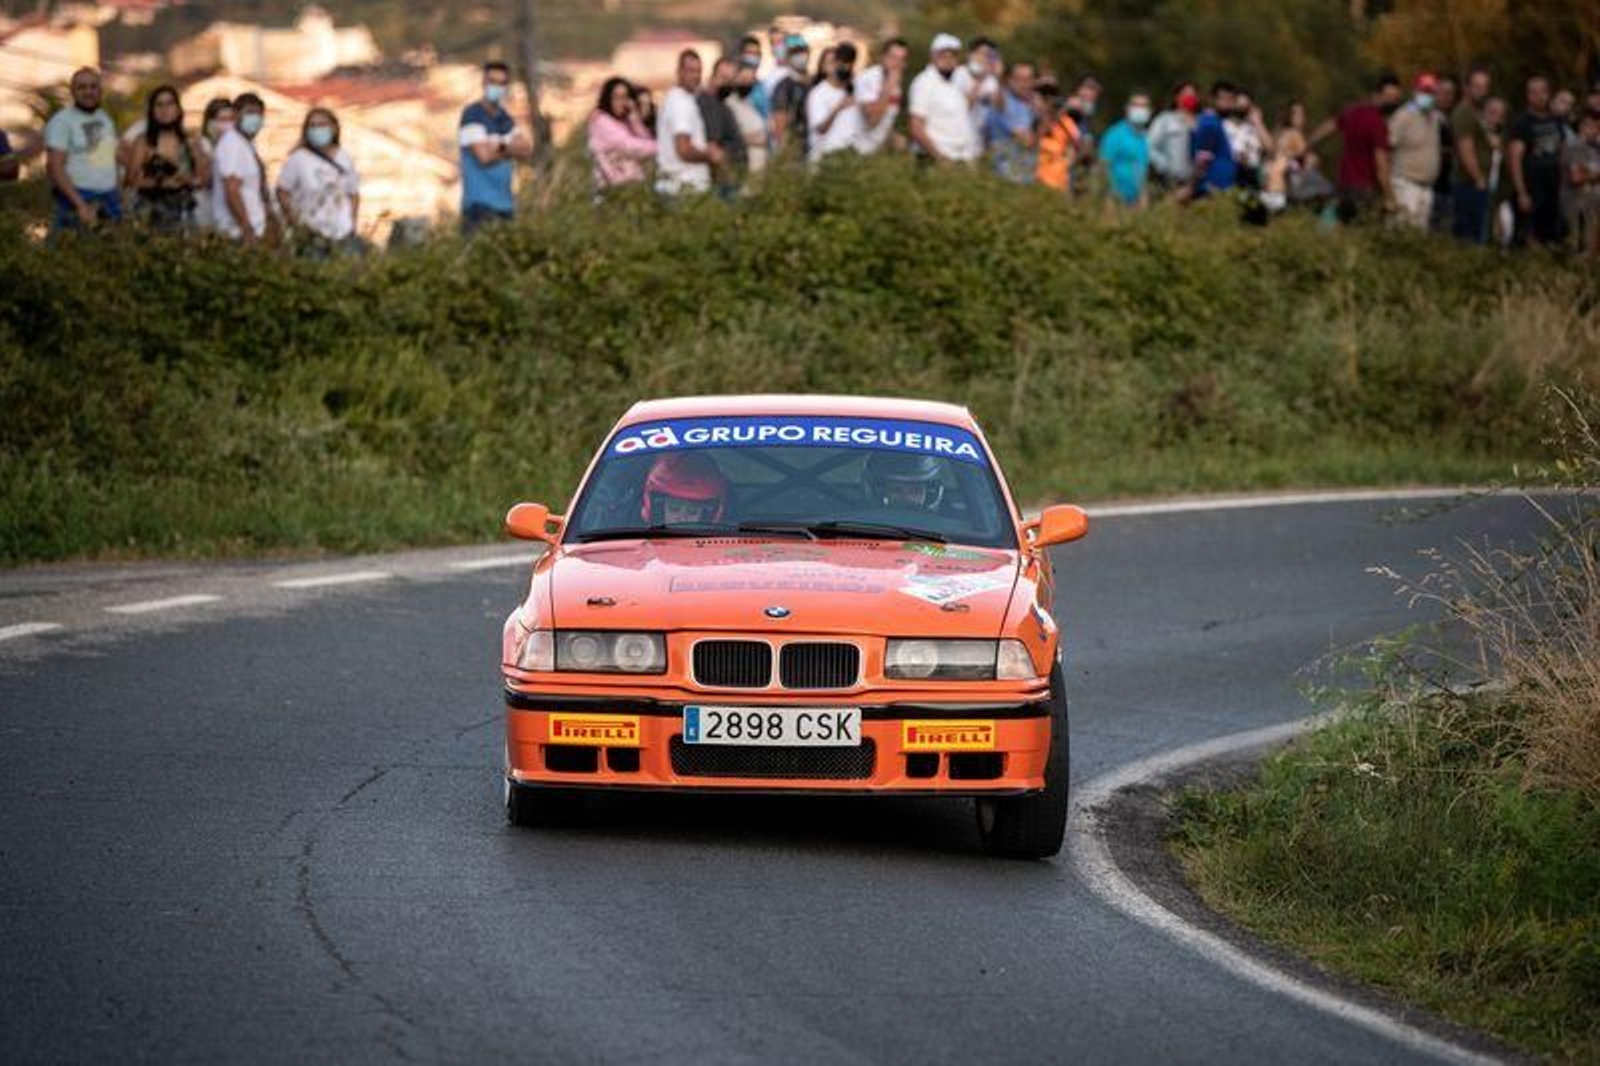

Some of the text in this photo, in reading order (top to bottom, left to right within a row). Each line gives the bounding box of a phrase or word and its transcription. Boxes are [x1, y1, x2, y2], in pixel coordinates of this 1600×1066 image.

[683, 425, 806, 443] GRUPO
[812, 426, 980, 460] REGUEIRA
[553, 719, 636, 739] PIRELLI
[706, 711, 853, 741] 2898 CSK
[907, 726, 992, 743] PIRELLI
